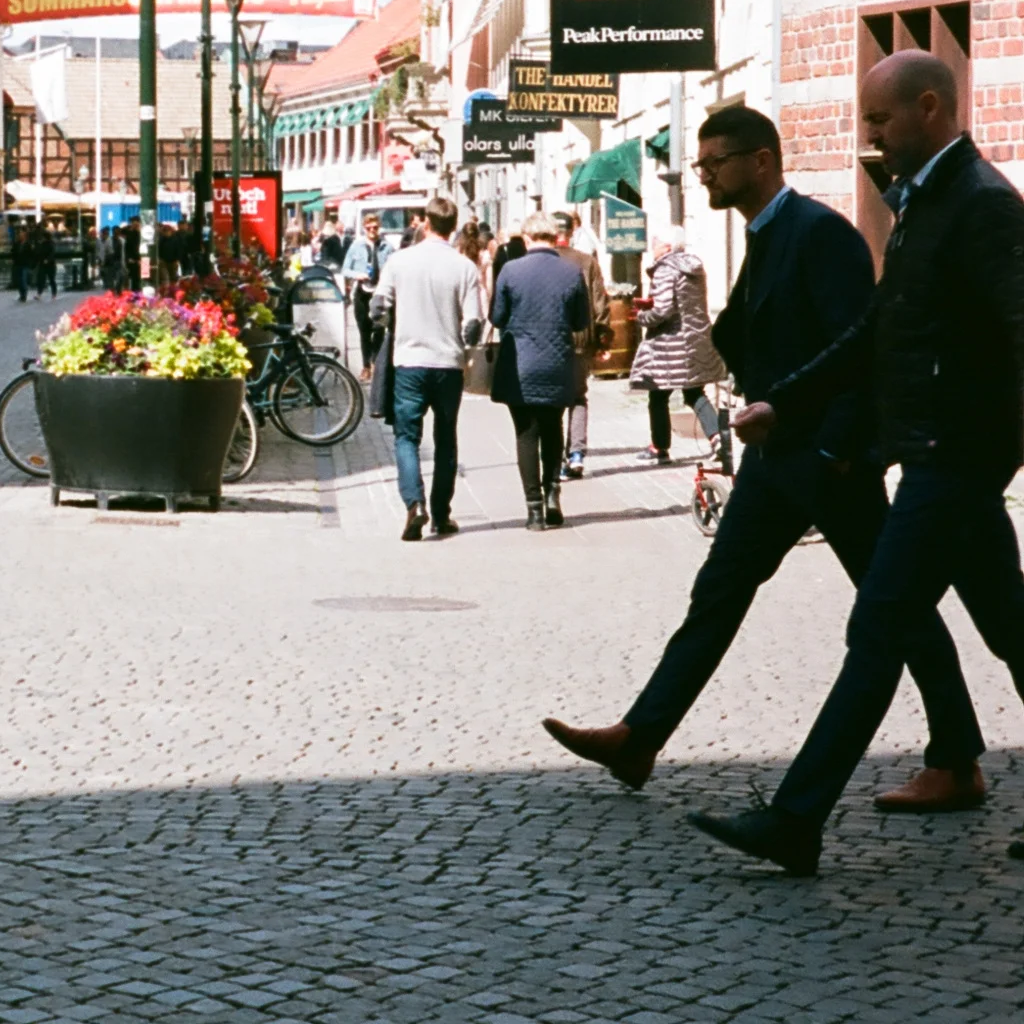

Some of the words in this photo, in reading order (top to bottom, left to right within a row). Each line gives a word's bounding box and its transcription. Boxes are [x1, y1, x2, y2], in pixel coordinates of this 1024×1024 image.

[508, 91, 617, 113] KONFEKTYRER
[479, 110, 502, 122] MK
[464, 135, 502, 151] olars
[508, 134, 535, 151] ulla
